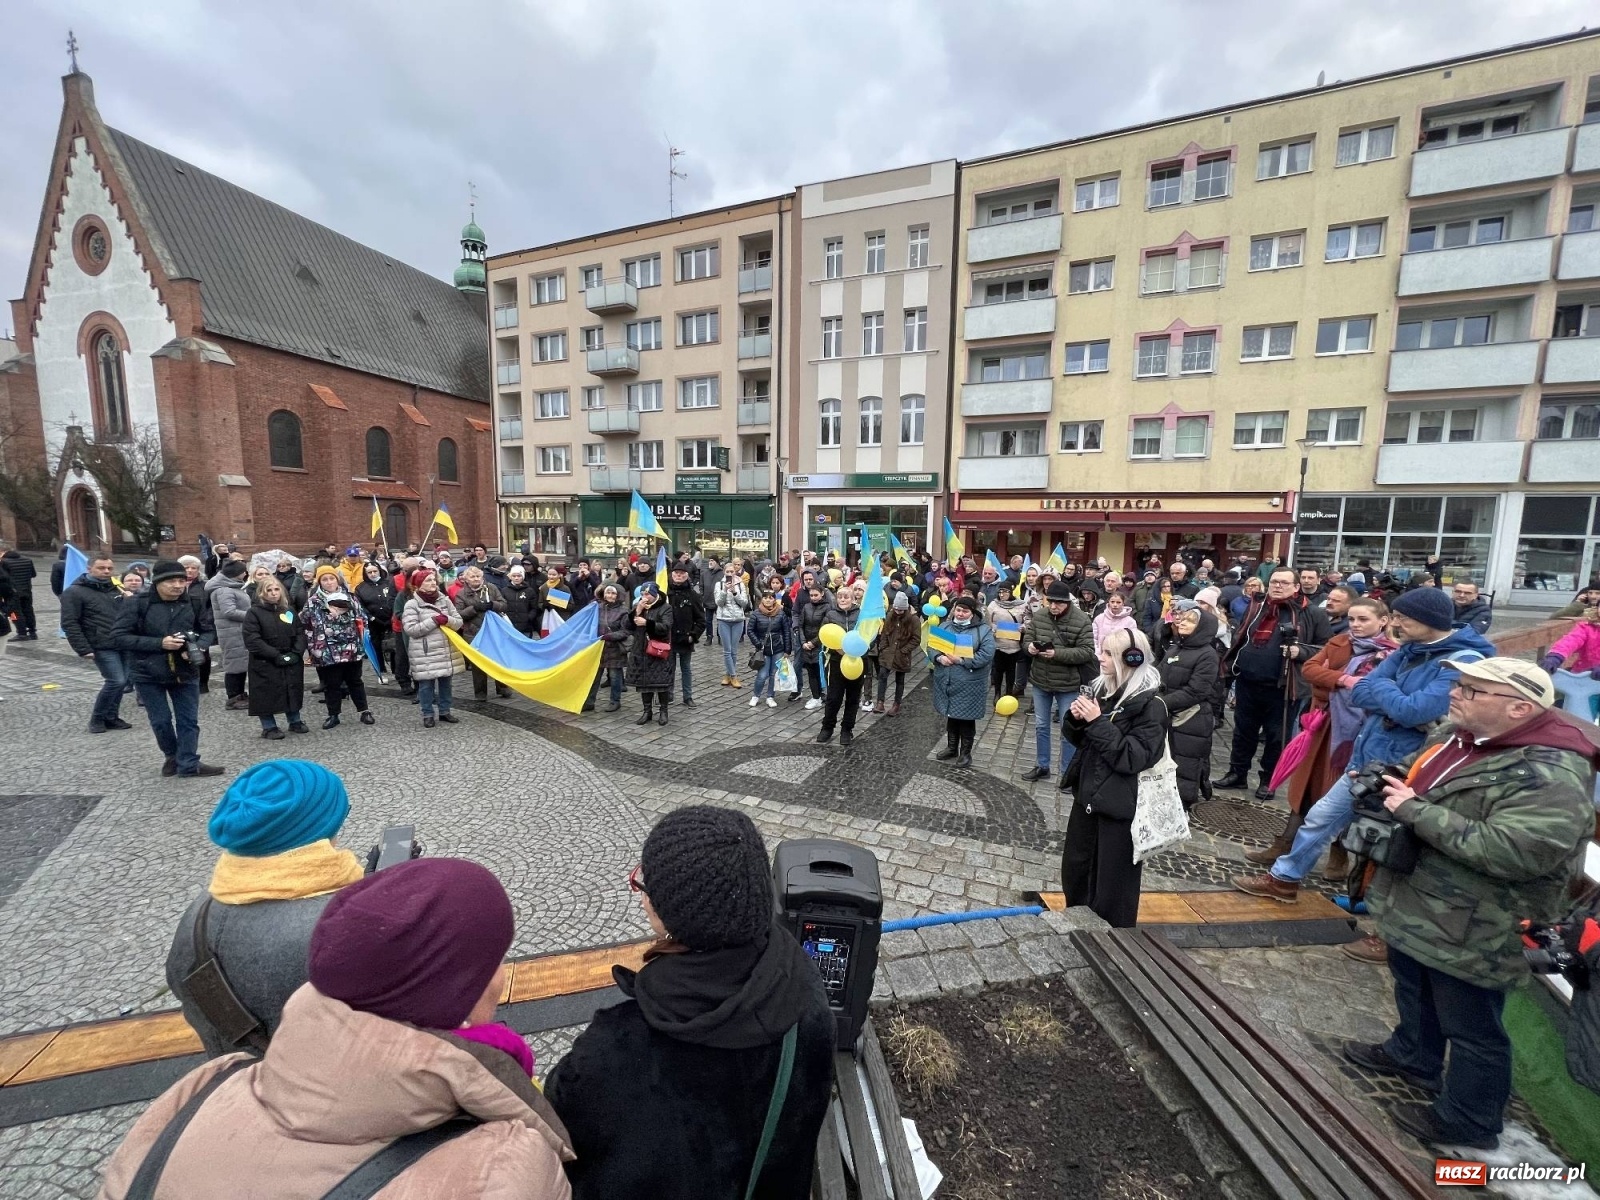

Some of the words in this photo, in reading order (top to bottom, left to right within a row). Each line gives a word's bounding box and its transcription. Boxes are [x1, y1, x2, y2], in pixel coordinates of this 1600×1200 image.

[650, 504, 702, 515] BILER
[1054, 499, 1162, 510] RESTAURACJA
[509, 504, 561, 520] STELLA
[1299, 510, 1338, 519] empik.com
[732, 530, 766, 539] CASIO
